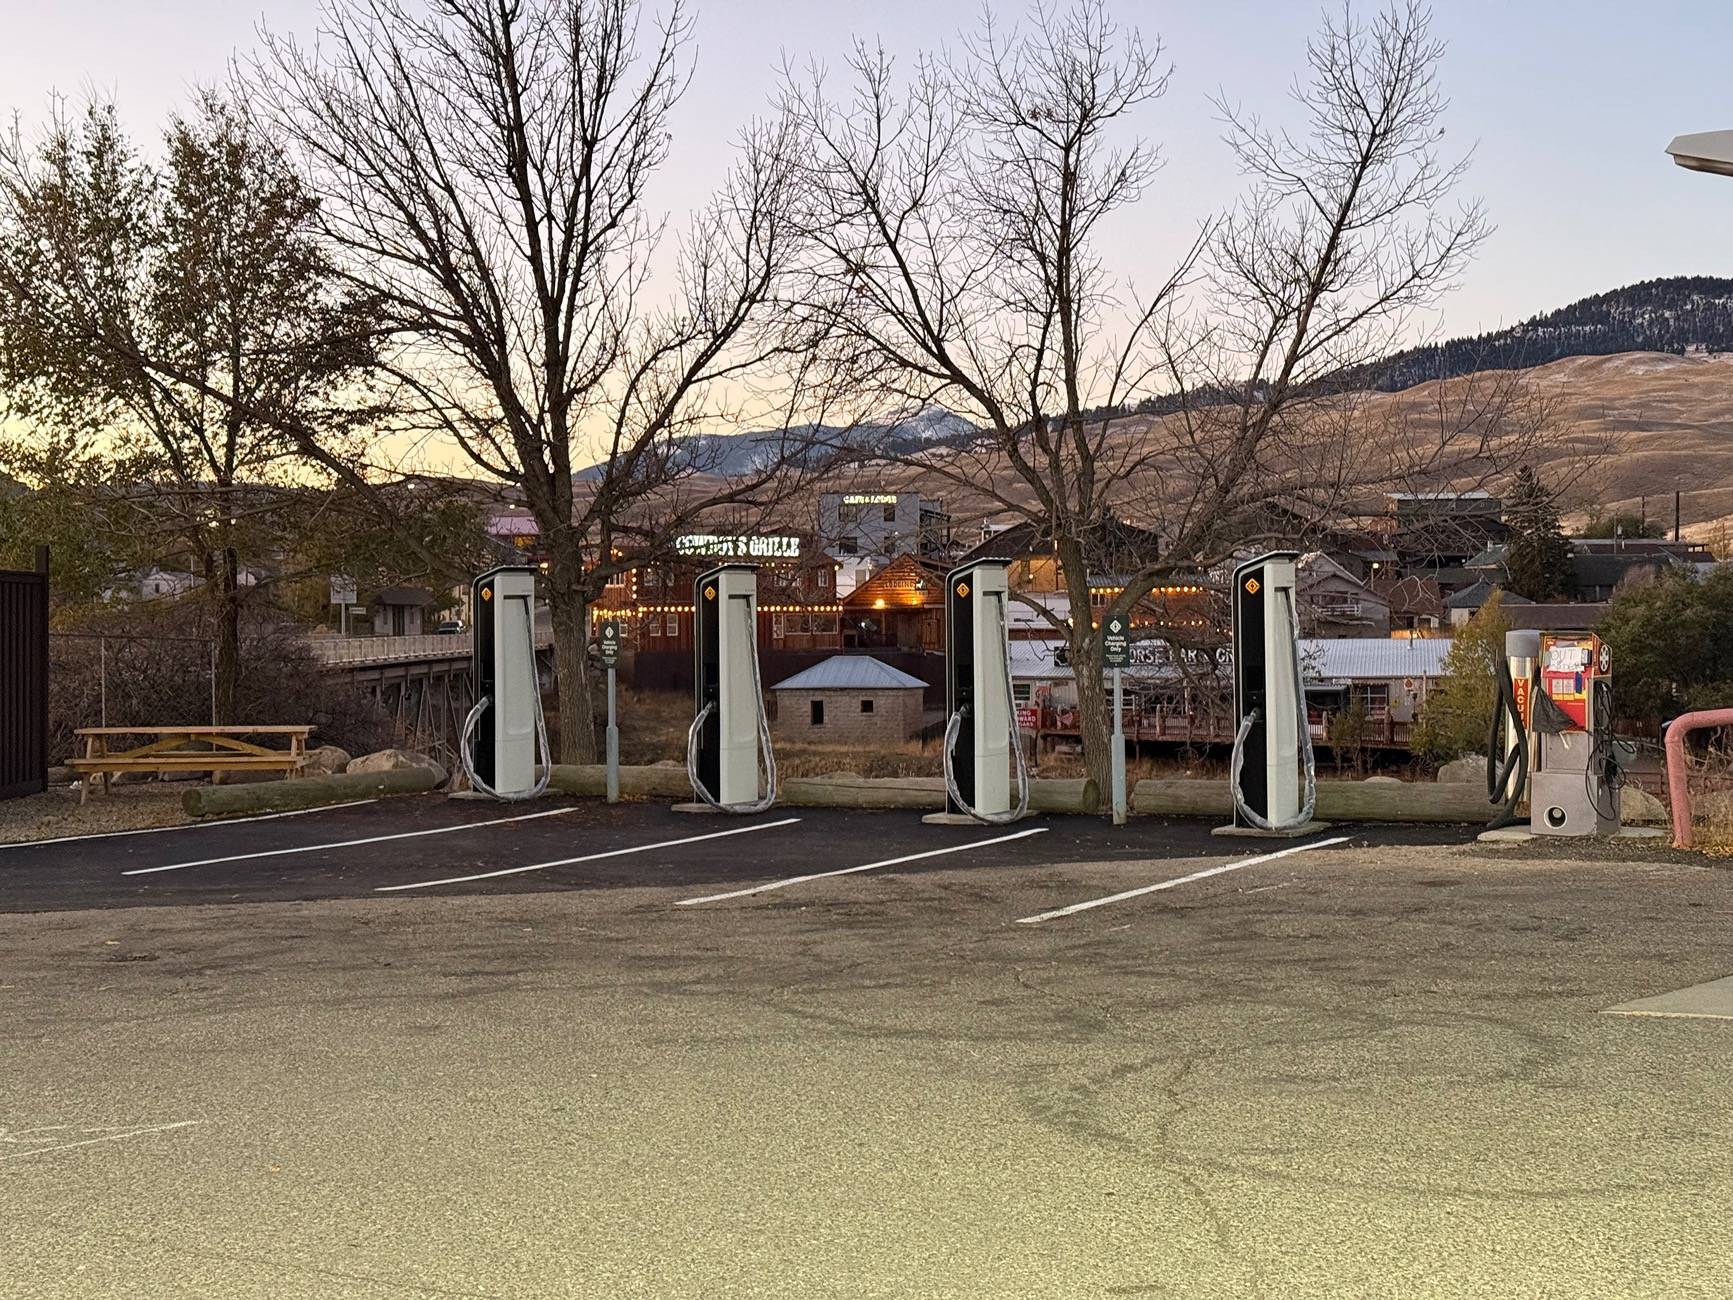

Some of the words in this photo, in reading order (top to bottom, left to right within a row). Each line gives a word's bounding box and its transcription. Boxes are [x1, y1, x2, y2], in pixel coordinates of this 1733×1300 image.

[749, 536, 800, 557] GRILLE
[1129, 648, 1163, 663] ORSE
[1516, 679, 1525, 726] VACU
